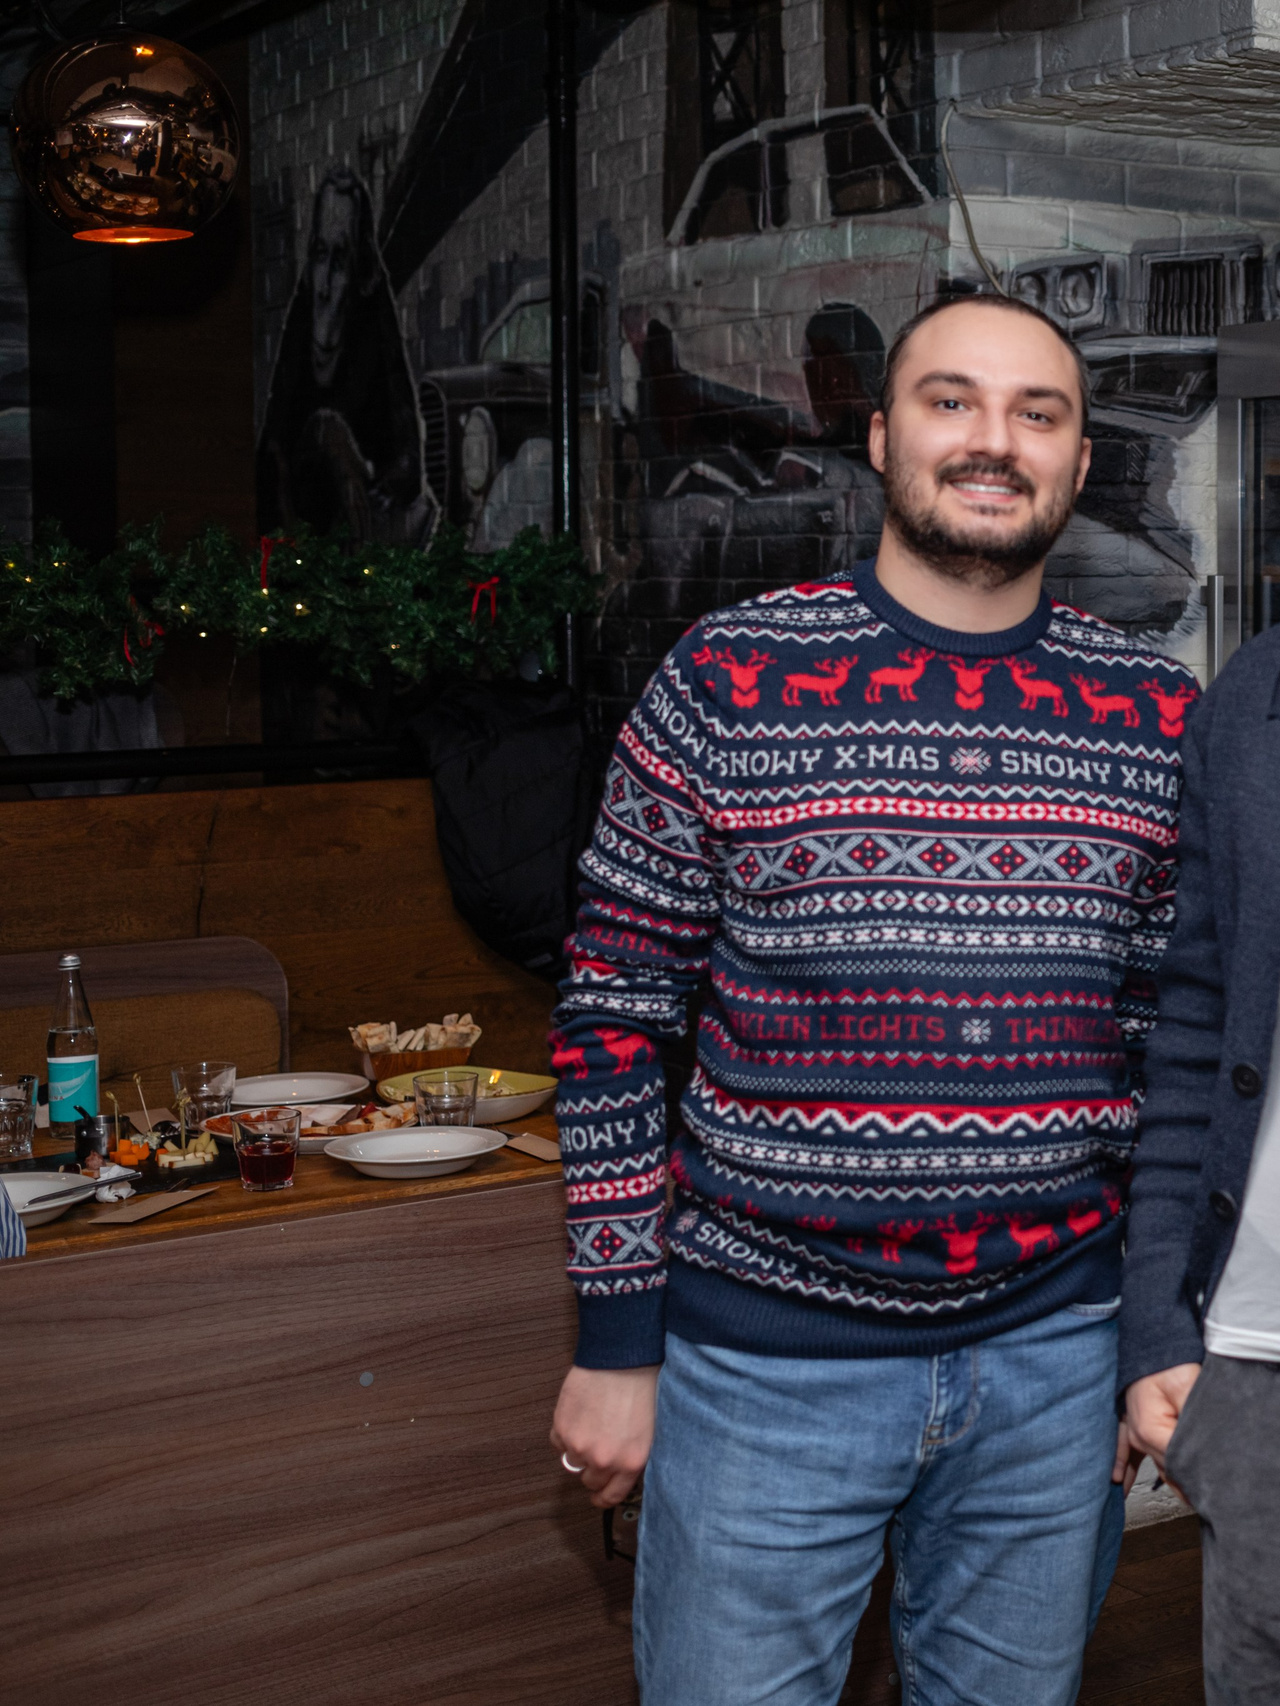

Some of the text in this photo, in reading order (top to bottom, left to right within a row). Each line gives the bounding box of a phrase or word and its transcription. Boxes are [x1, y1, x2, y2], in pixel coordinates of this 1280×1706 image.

[834, 744, 940, 771] X-MAS
[1000, 749, 1112, 784] SNOWY
[1120, 763, 1183, 801] X-MA
[819, 1014, 946, 1043] LIGHTS
